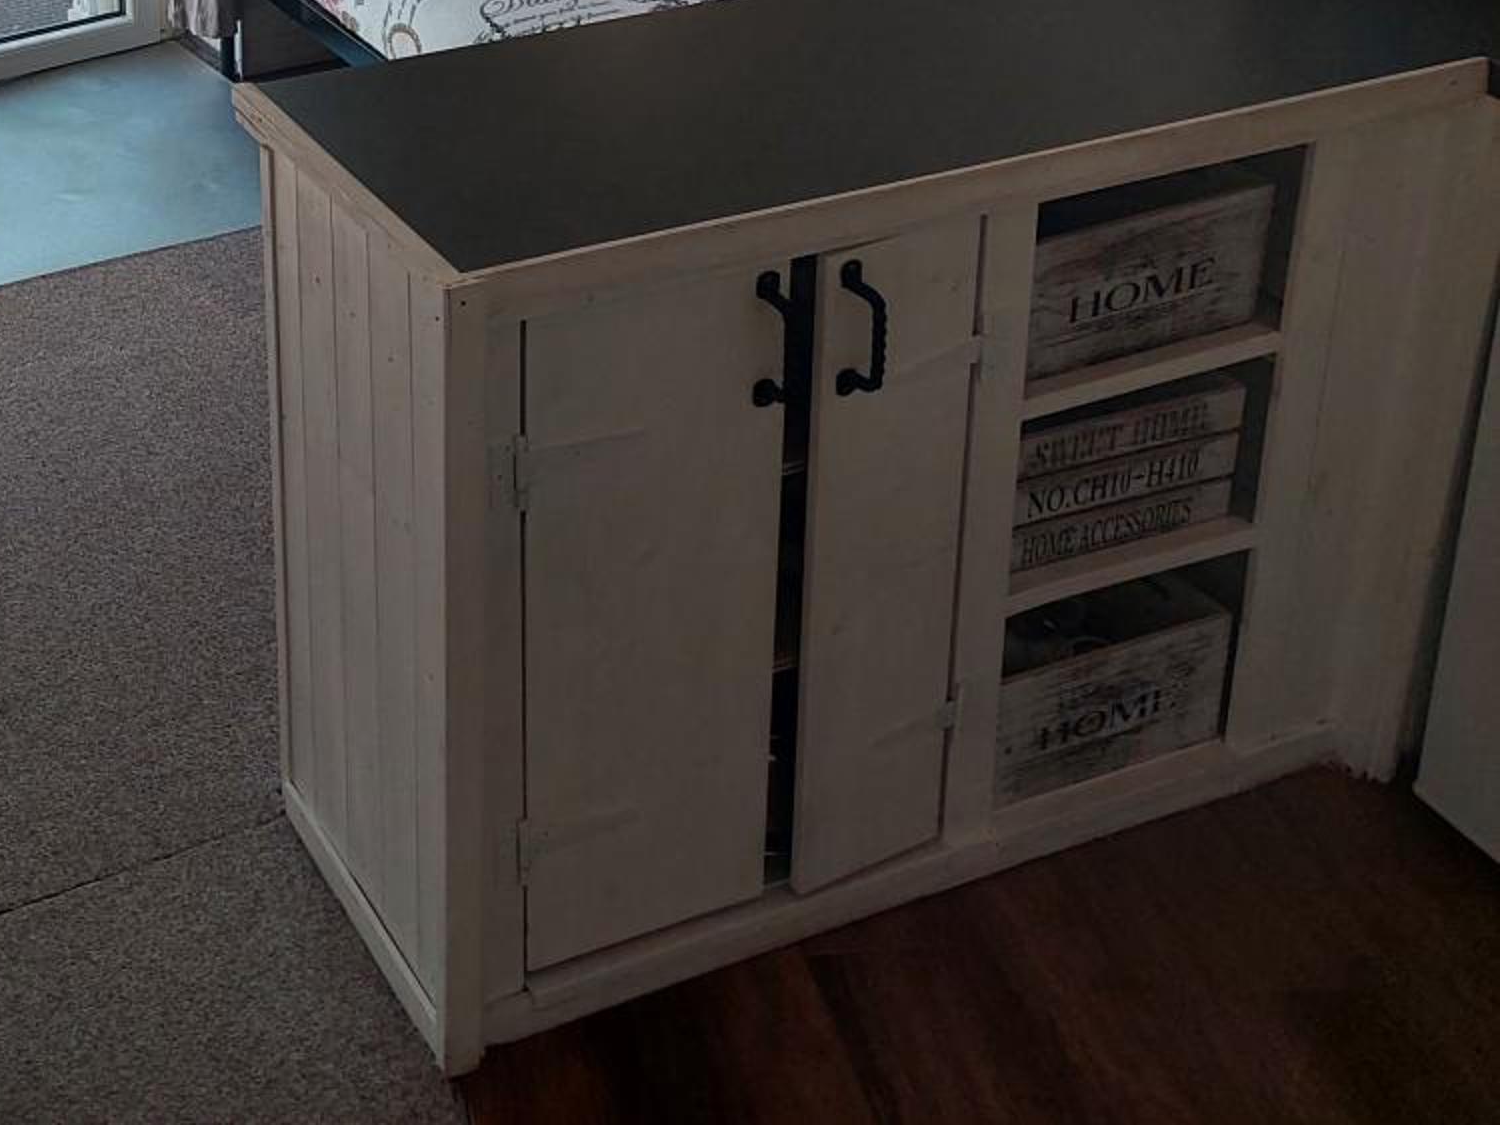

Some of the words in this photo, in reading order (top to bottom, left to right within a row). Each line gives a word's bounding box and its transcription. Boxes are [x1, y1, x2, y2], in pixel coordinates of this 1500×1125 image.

[1068, 256, 1216, 323] HOME
[1021, 527, 1077, 564] HOME
[1078, 499, 1192, 550] ACCESSORIES
